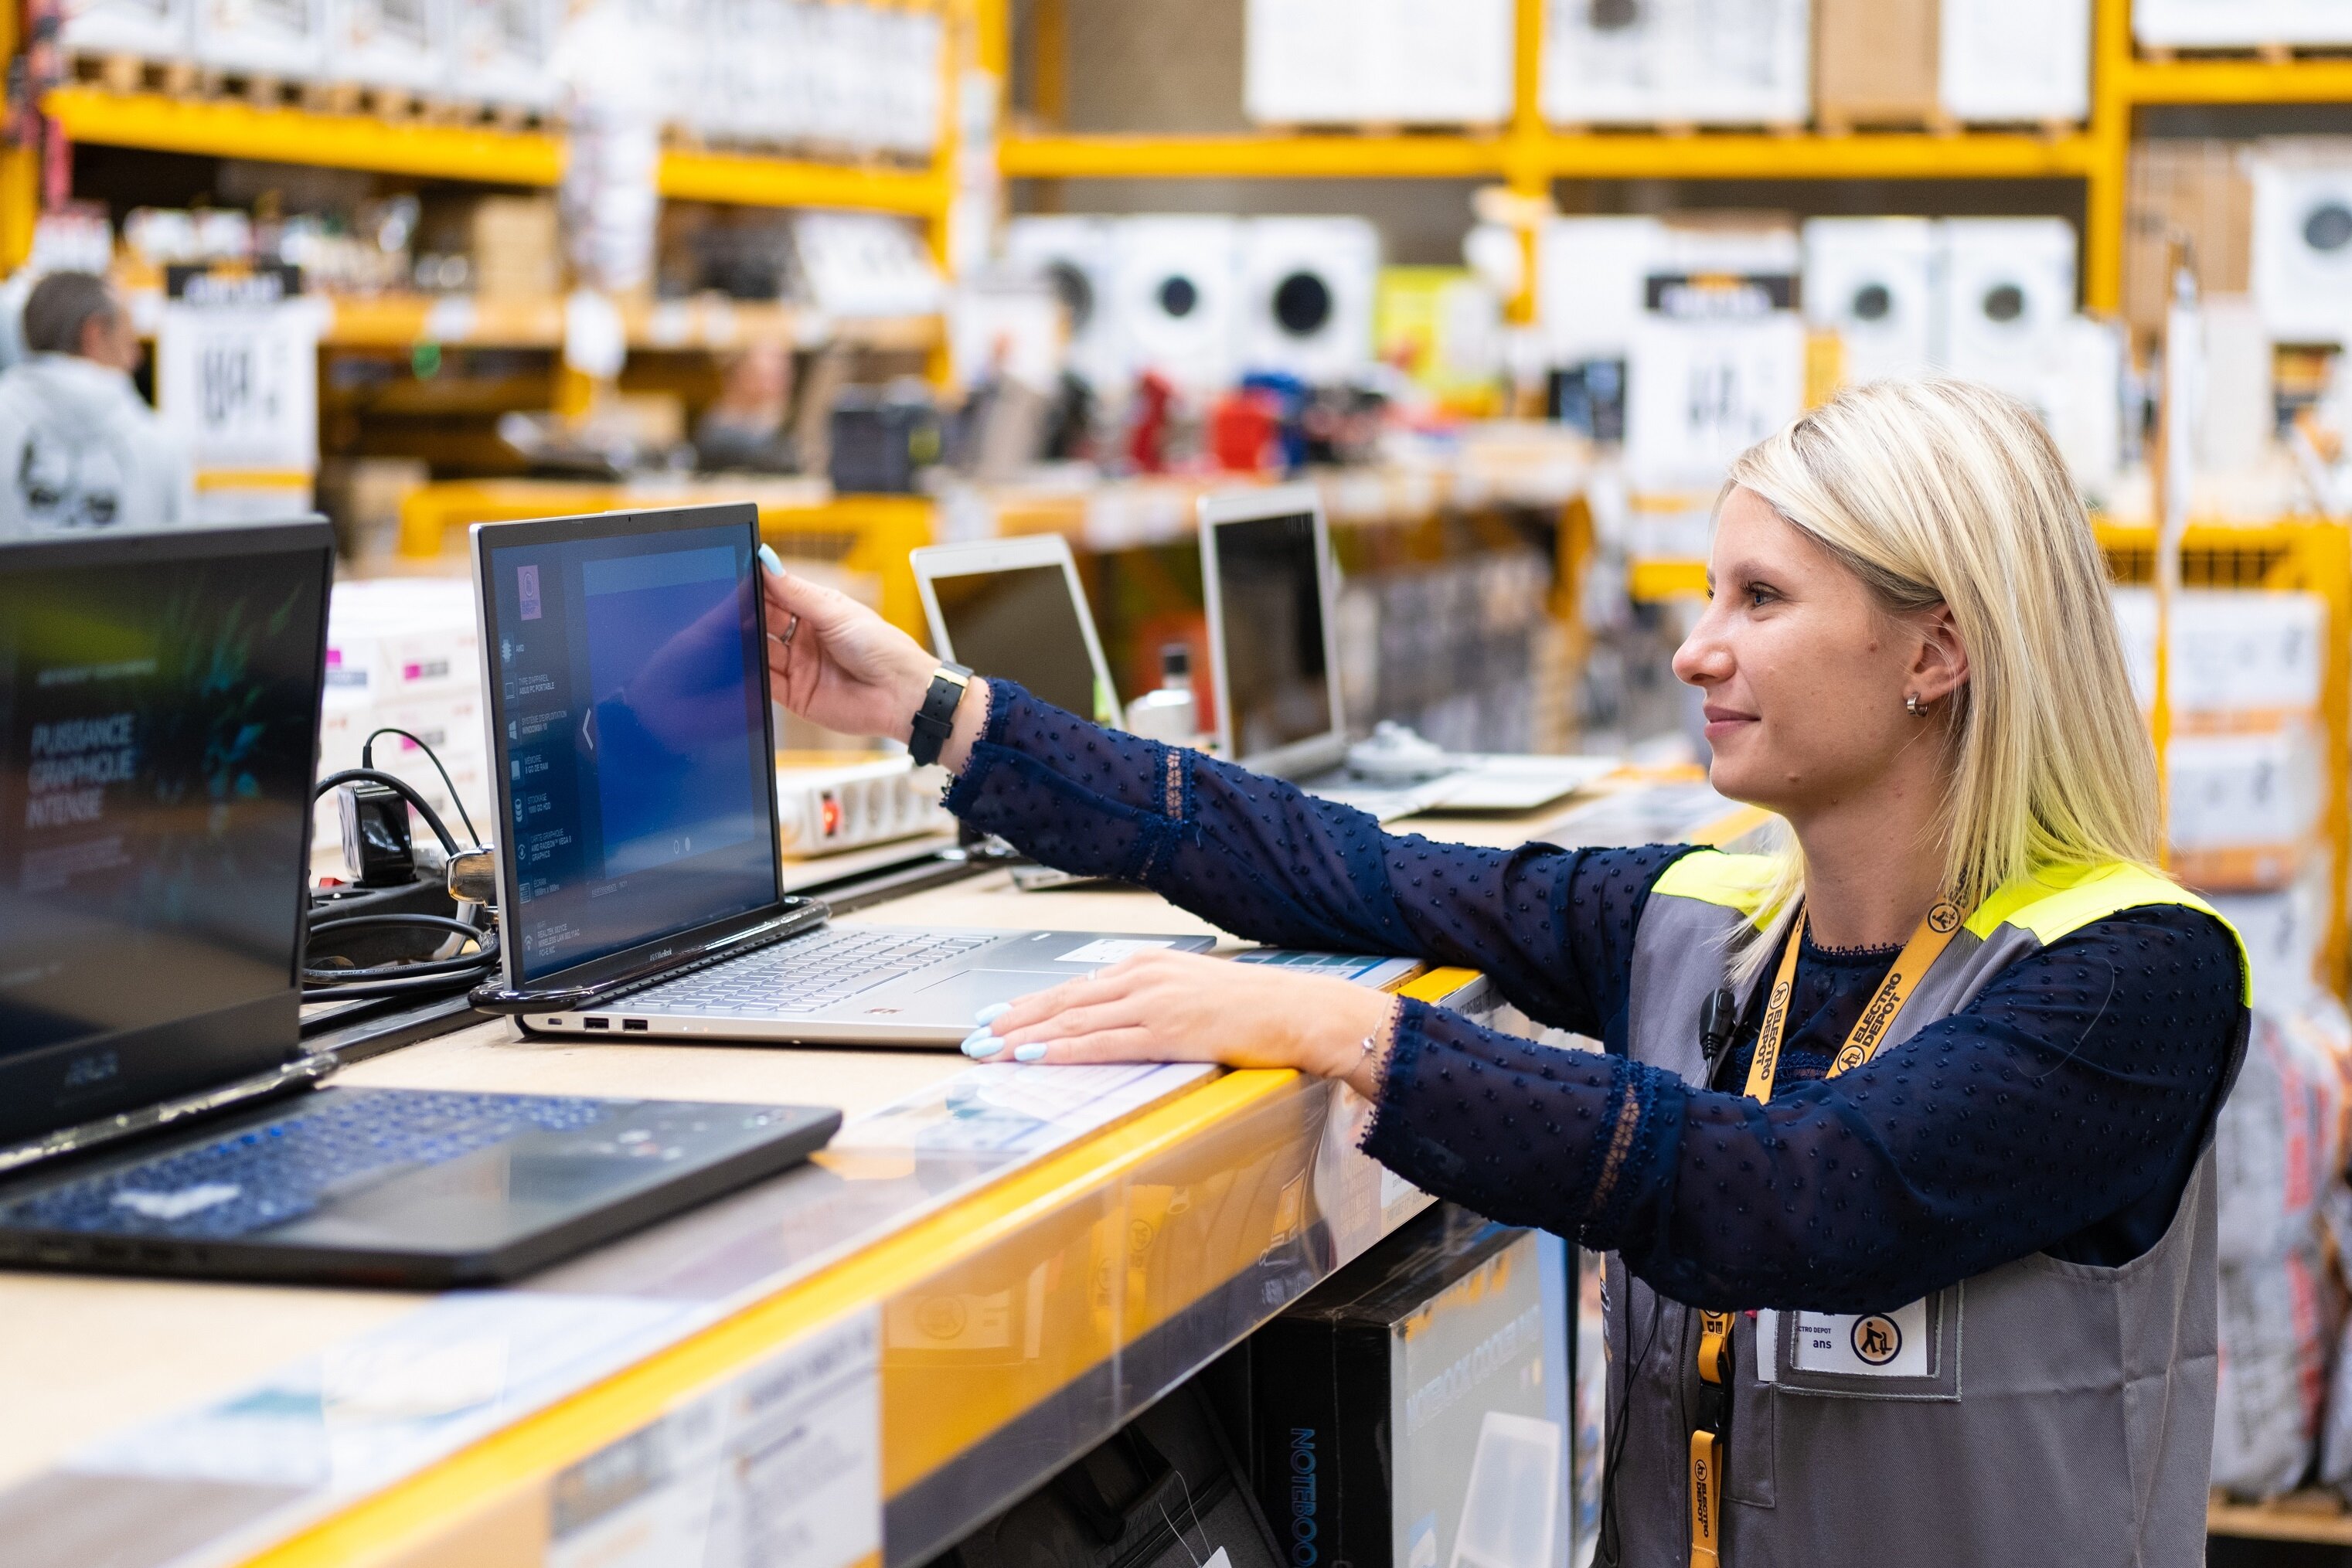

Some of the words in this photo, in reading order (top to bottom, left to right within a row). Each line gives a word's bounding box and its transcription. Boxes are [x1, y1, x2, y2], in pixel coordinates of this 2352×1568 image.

[535, 682, 555, 692] PORTABLE
[540, 763, 549, 771] RAM
[527, 794, 547, 804] STOCKAGE
[530, 834, 543, 843] CARTE
[543, 828, 564, 841] GRAPHIQUE
[531, 845, 540, 853] AMD
[558, 838, 569, 846] VEGA
[532, 851, 550, 862] GRAPHICS
[538, 927, 554, 940] REALTEK
[538, 936, 557, 947] WIRELESS
[1852, 972, 1902, 1043] ELECTRO
[1861, 992, 1901, 1048] DEPOT
[1756, 1011, 1775, 1066] DEPOT
[1761, 1008, 1782, 1080] ELECTRO
[1813, 1340, 1832, 1349] ans
[1290, 1428, 1319, 1568] NOTEBOO
